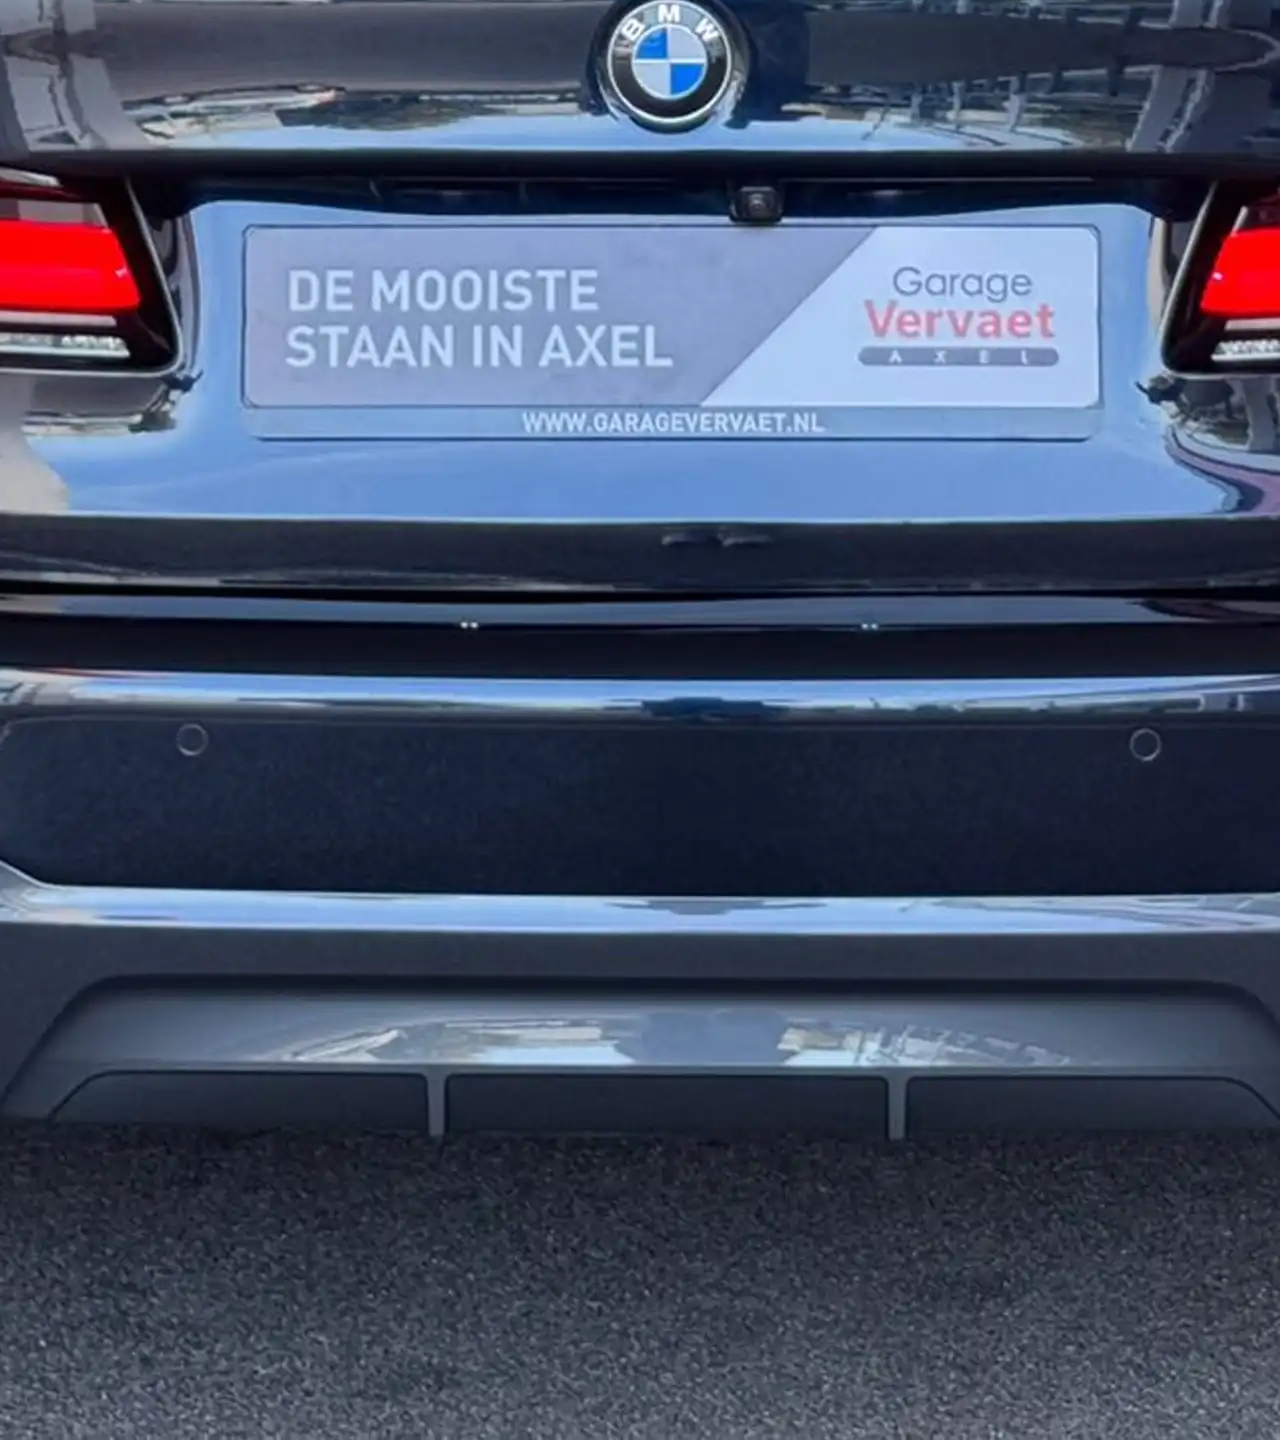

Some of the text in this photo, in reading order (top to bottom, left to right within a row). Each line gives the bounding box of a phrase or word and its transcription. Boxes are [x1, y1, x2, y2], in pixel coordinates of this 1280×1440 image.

[621, 4, 718, 42] BMW
[288, 269, 599, 312] DE MOOISTE
[892, 265, 1033, 304] Garage
[863, 299, 1056, 339] Vervaet
[285, 324, 674, 368] STAAN IN AXEL
[520, 410, 826, 433] WWW.GARAGEVERVAET.NL
